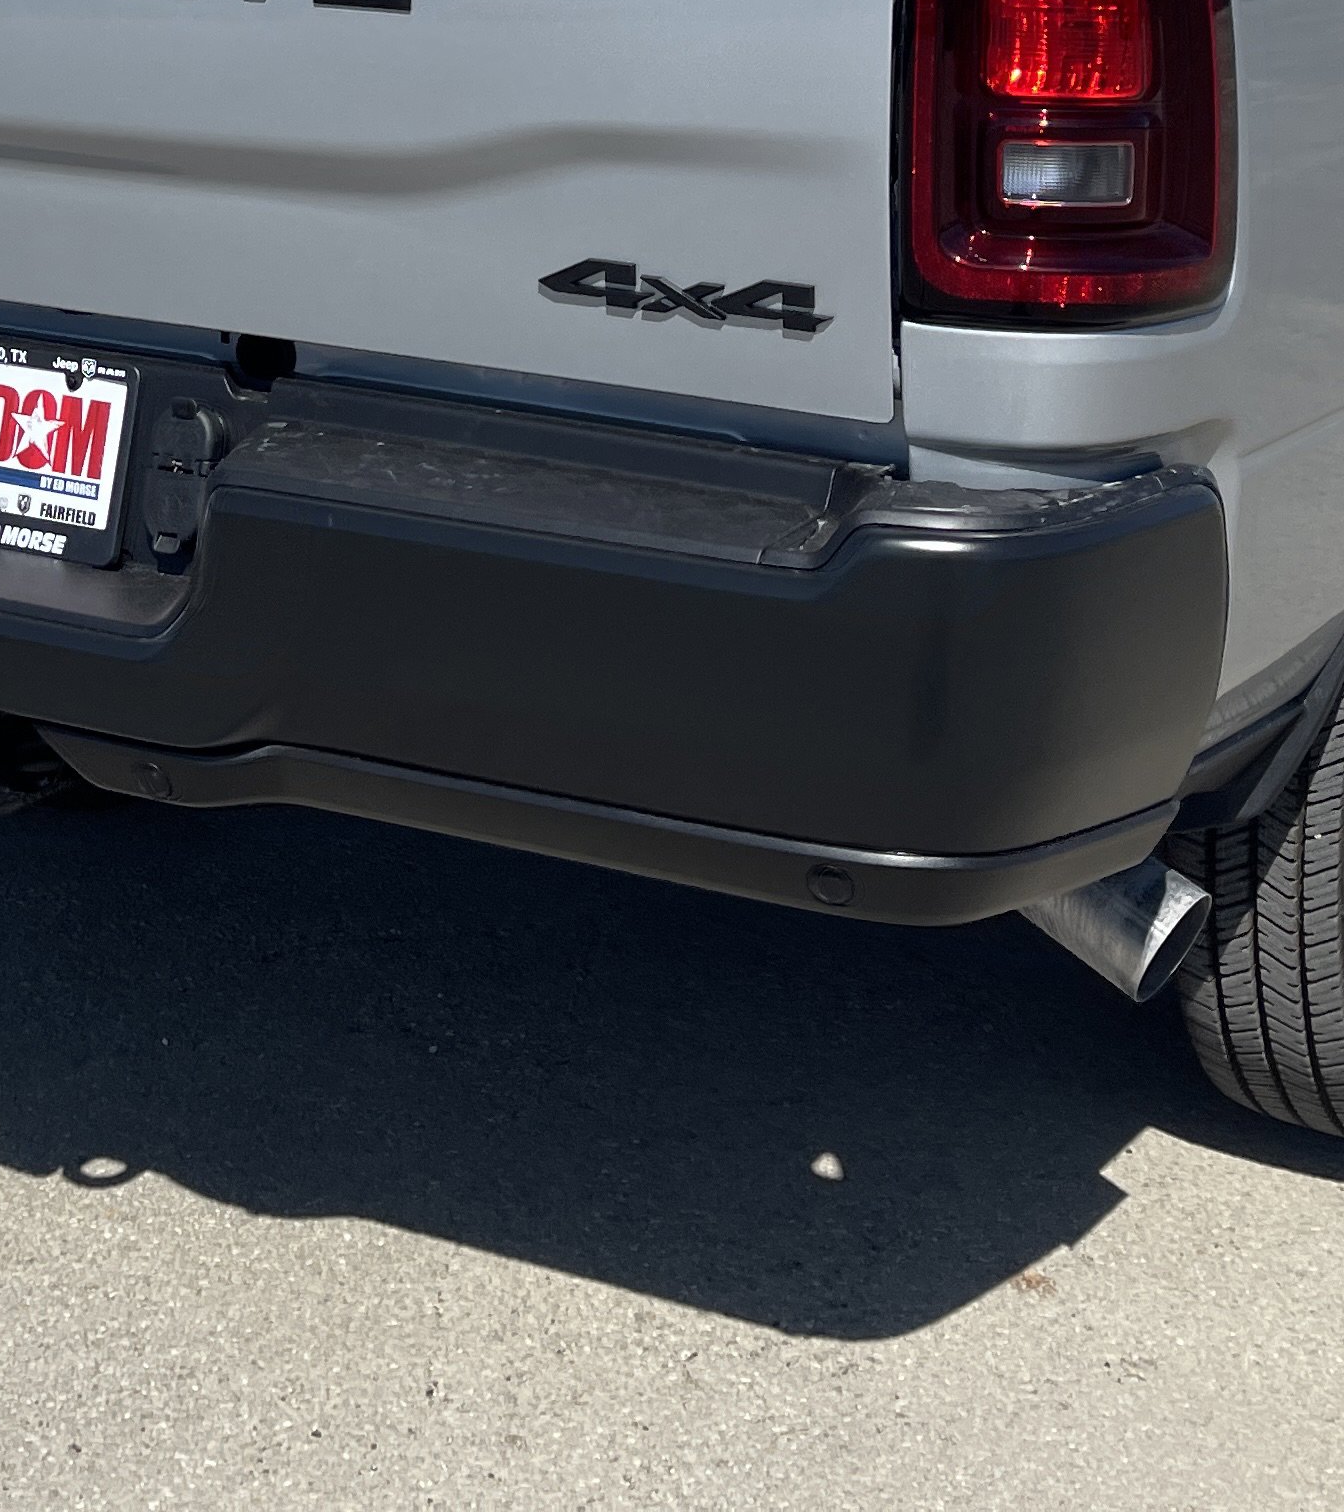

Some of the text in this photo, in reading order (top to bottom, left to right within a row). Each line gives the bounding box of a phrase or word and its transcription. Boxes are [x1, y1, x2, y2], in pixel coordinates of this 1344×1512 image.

[10, 349, 27, 363] TX
[52, 357, 79, 372] Jeep
[97, 366, 126, 378] RAM
[39, 475, 97, 497] BY ED MORSE
[40, 503, 96, 526] FAIRFIELD
[0, 524, 67, 555] MORSE
